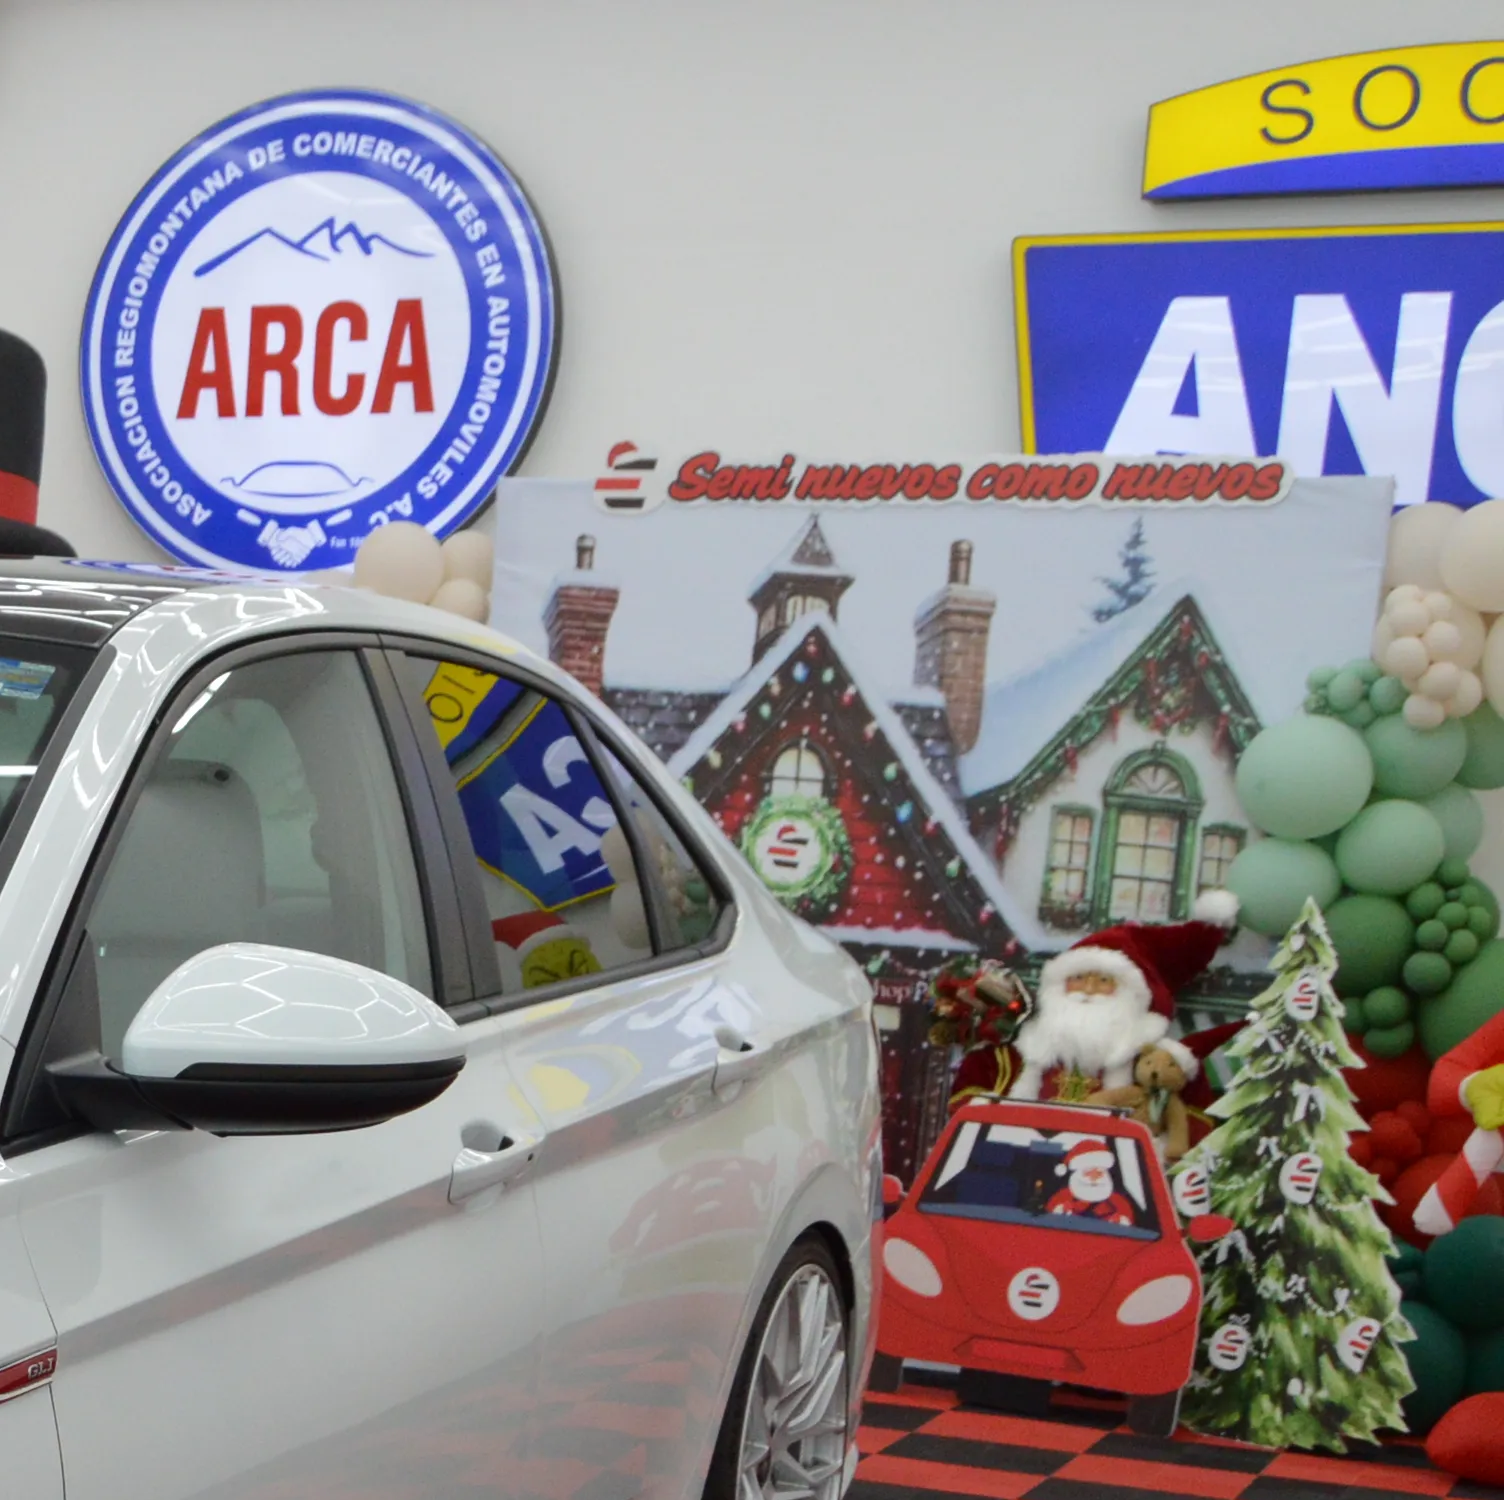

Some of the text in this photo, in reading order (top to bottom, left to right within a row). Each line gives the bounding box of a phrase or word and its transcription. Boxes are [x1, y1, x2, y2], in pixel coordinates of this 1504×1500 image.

[246, 139, 286, 171] DE
[293, 131, 488, 242] COMERCIANTES
[115, 160, 243, 367] REGIOMONTANA
[475, 242, 506, 289] EN
[176, 297, 435, 420] ARCA
[417, 295, 511, 499] AUTOMOVILES
[115, 374, 212, 526] ASOCIACION
[668, 450, 1285, 501] Semi nuevos como nuevos
[27, 1357, 55, 1380] GLI
